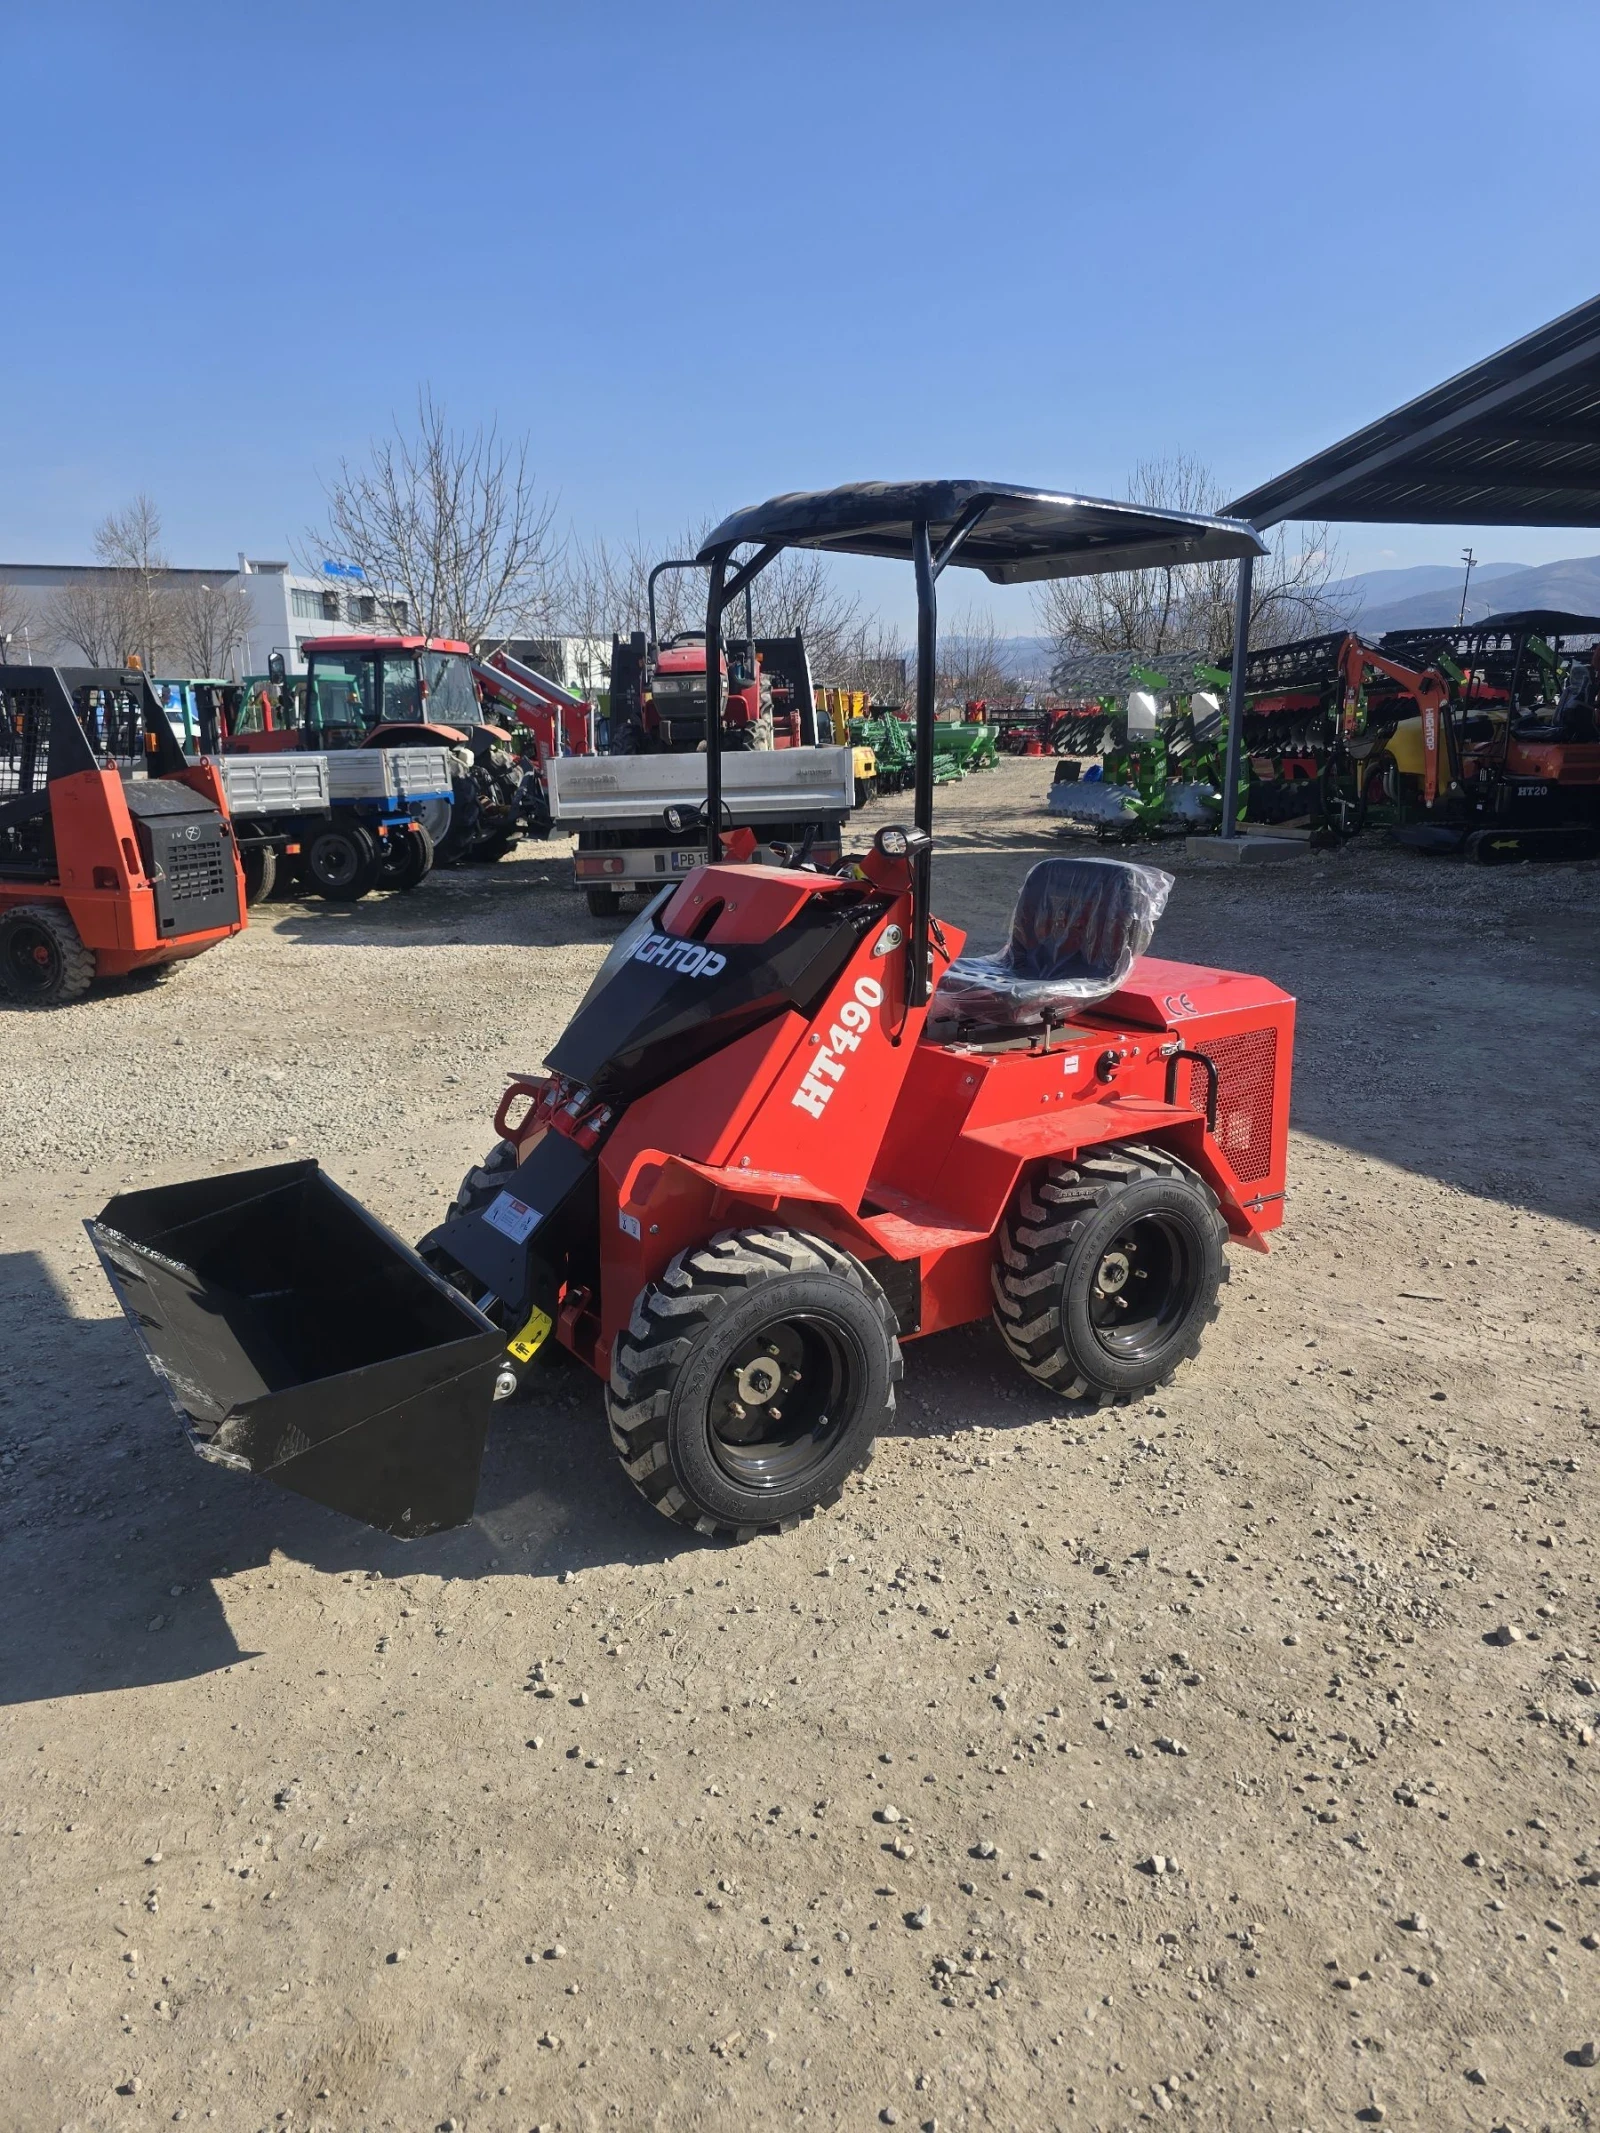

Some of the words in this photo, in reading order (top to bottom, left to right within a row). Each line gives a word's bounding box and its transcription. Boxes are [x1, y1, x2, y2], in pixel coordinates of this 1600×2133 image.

[1425, 707, 1435, 750] HIGHTOP
[1517, 786, 1548, 796] HT20
[680, 853, 695, 866] PB
[619, 933, 727, 978] HIGHTOP
[791, 976, 884, 1120] HT490
